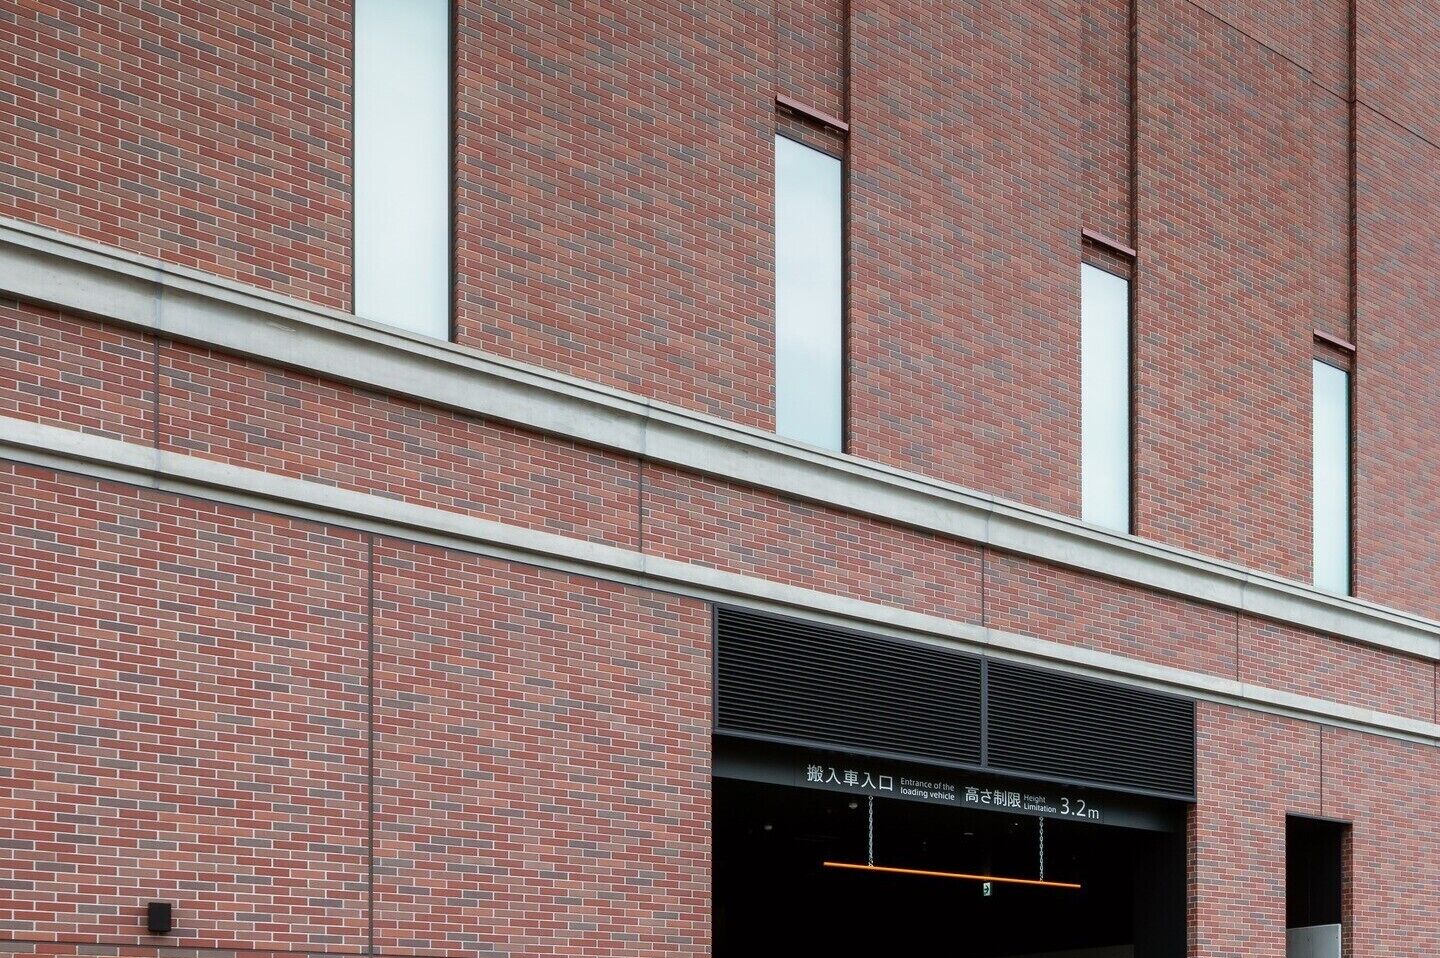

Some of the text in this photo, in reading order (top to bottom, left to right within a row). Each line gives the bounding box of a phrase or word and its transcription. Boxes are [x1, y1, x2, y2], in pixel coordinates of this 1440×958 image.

[806, 764, 893, 792] 搬入車入口
[900, 777, 955, 792] Entrance of the
[900, 786, 955, 801] loading vehicle
[965, 786, 1021, 808] 高さ制限
[1023, 794, 1046, 804] Height
[1023, 803, 1057, 814] Limitation
